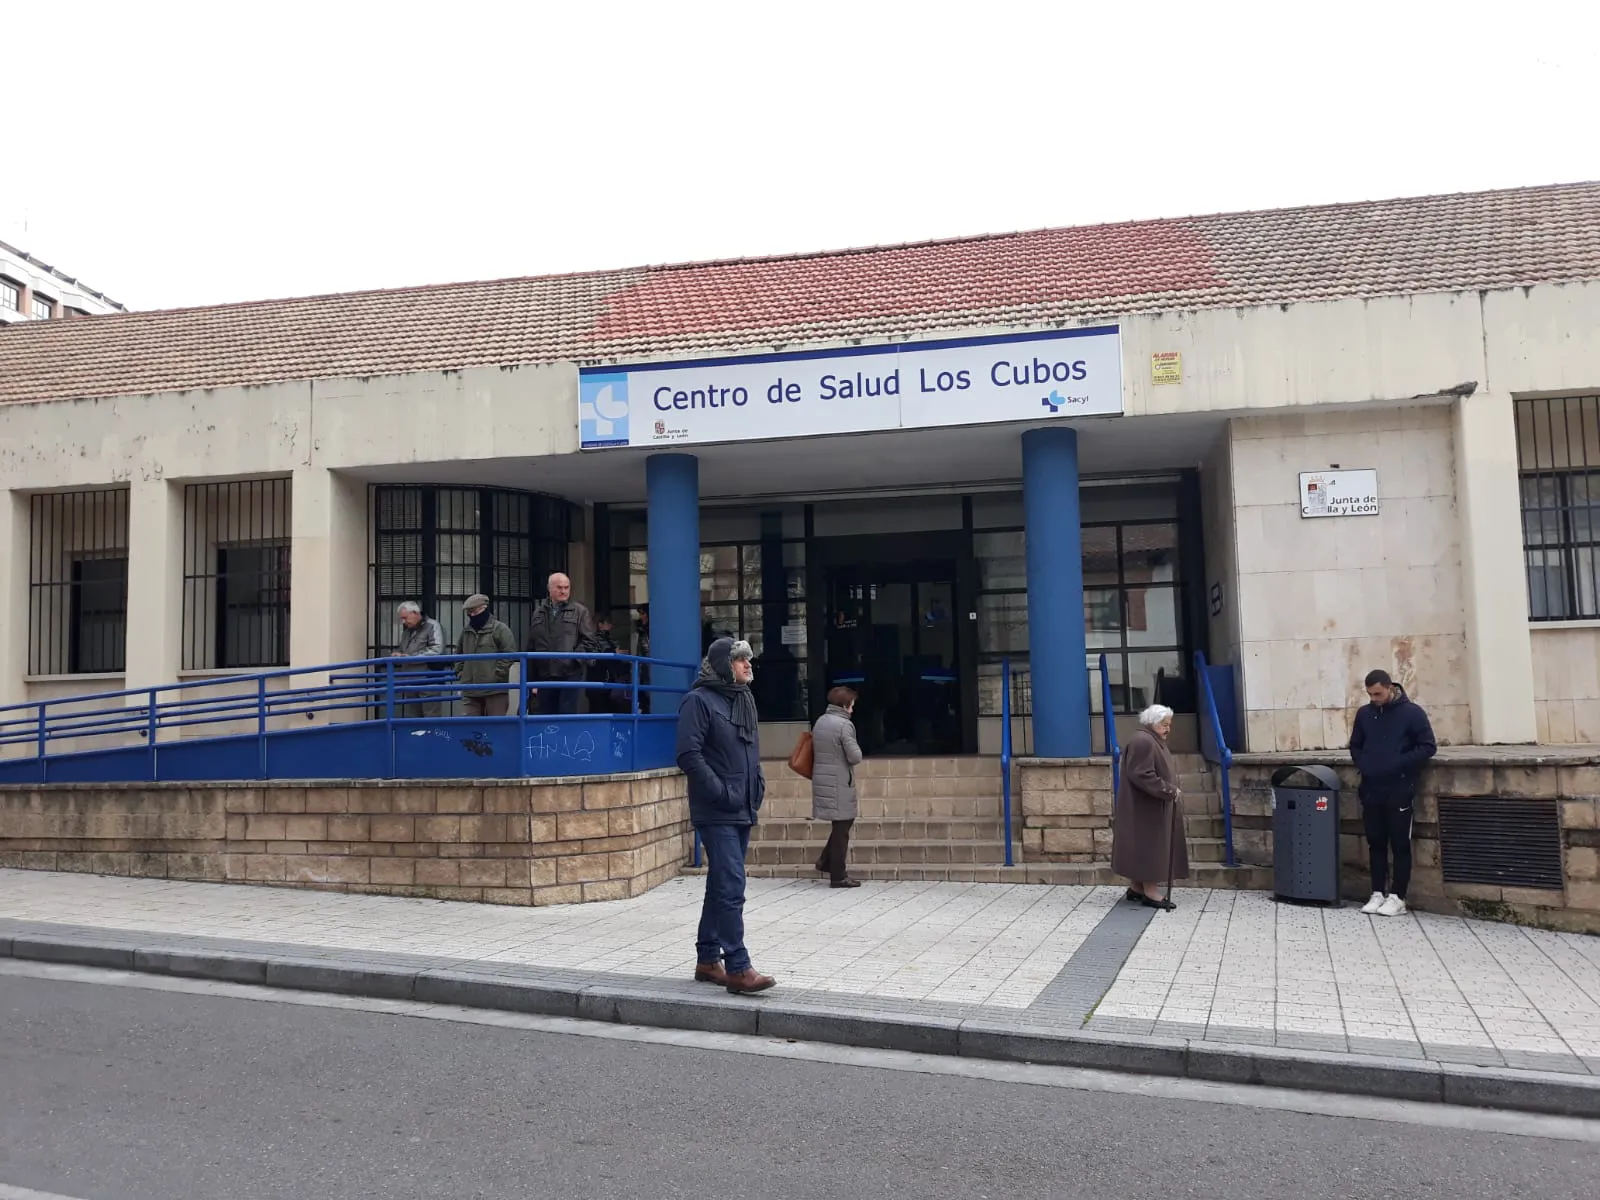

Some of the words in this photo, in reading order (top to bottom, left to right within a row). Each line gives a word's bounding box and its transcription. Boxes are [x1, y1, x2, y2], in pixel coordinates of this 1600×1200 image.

[653, 384, 748, 411] Centro
[767, 377, 801, 404] de
[819, 368, 900, 400] Salud
[920, 367, 971, 393] Los
[990, 357, 1087, 387] Cubos
[1067, 395, 1089, 405] Sacyl
[1330, 496, 1360, 505] Junta
[1363, 495, 1377, 504] de
[1302, 505, 1339, 515] Clla
[1342, 505, 1348, 515] y
[1351, 504, 1377, 512] León
